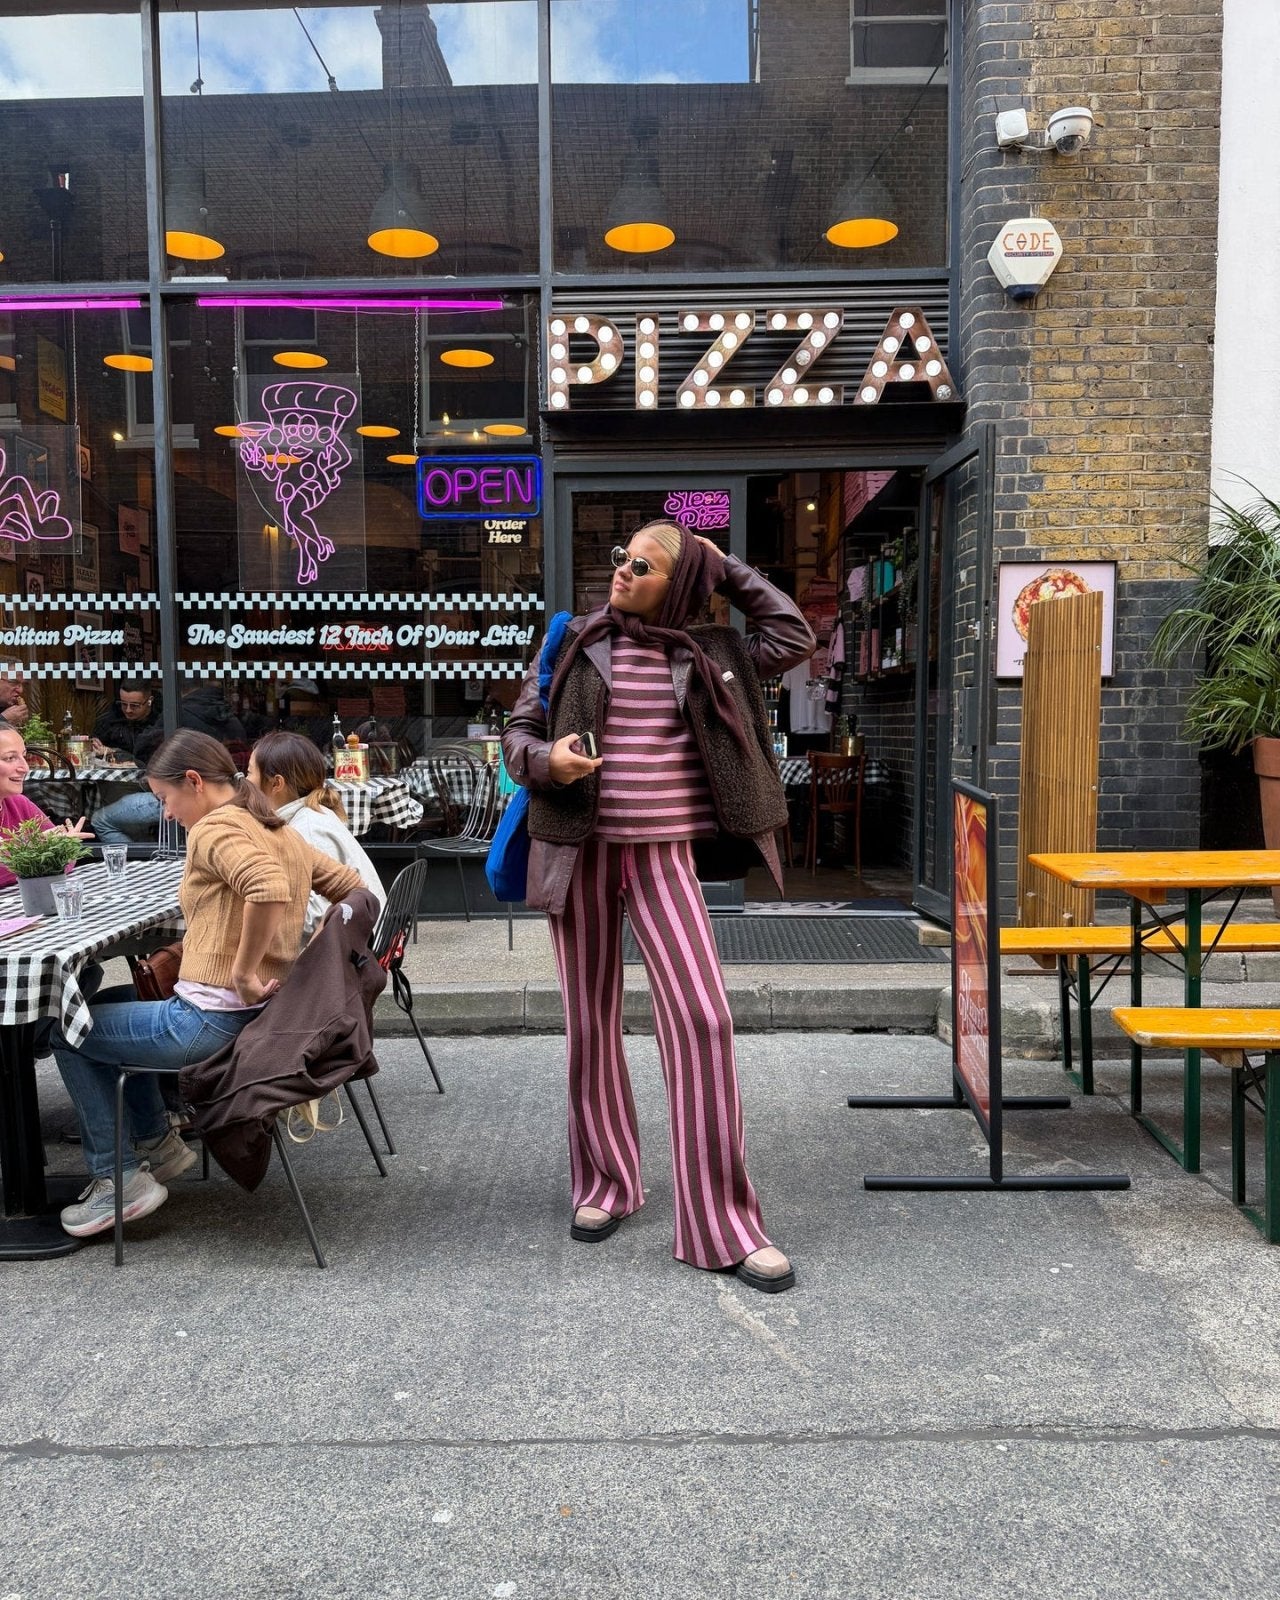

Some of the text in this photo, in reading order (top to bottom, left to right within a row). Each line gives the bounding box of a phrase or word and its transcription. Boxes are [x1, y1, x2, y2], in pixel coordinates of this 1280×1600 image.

[1003, 233, 1055, 251] CODE
[547, 307, 957, 411] PIZZA
[425, 468, 533, 505] OPEN
[484, 520, 526, 530] Order
[488, 531, 522, 544] Here
[63, 624, 125, 647] Pizza
[187, 623, 535, 649] The Sauciest 12 Inch Of Your Life!
